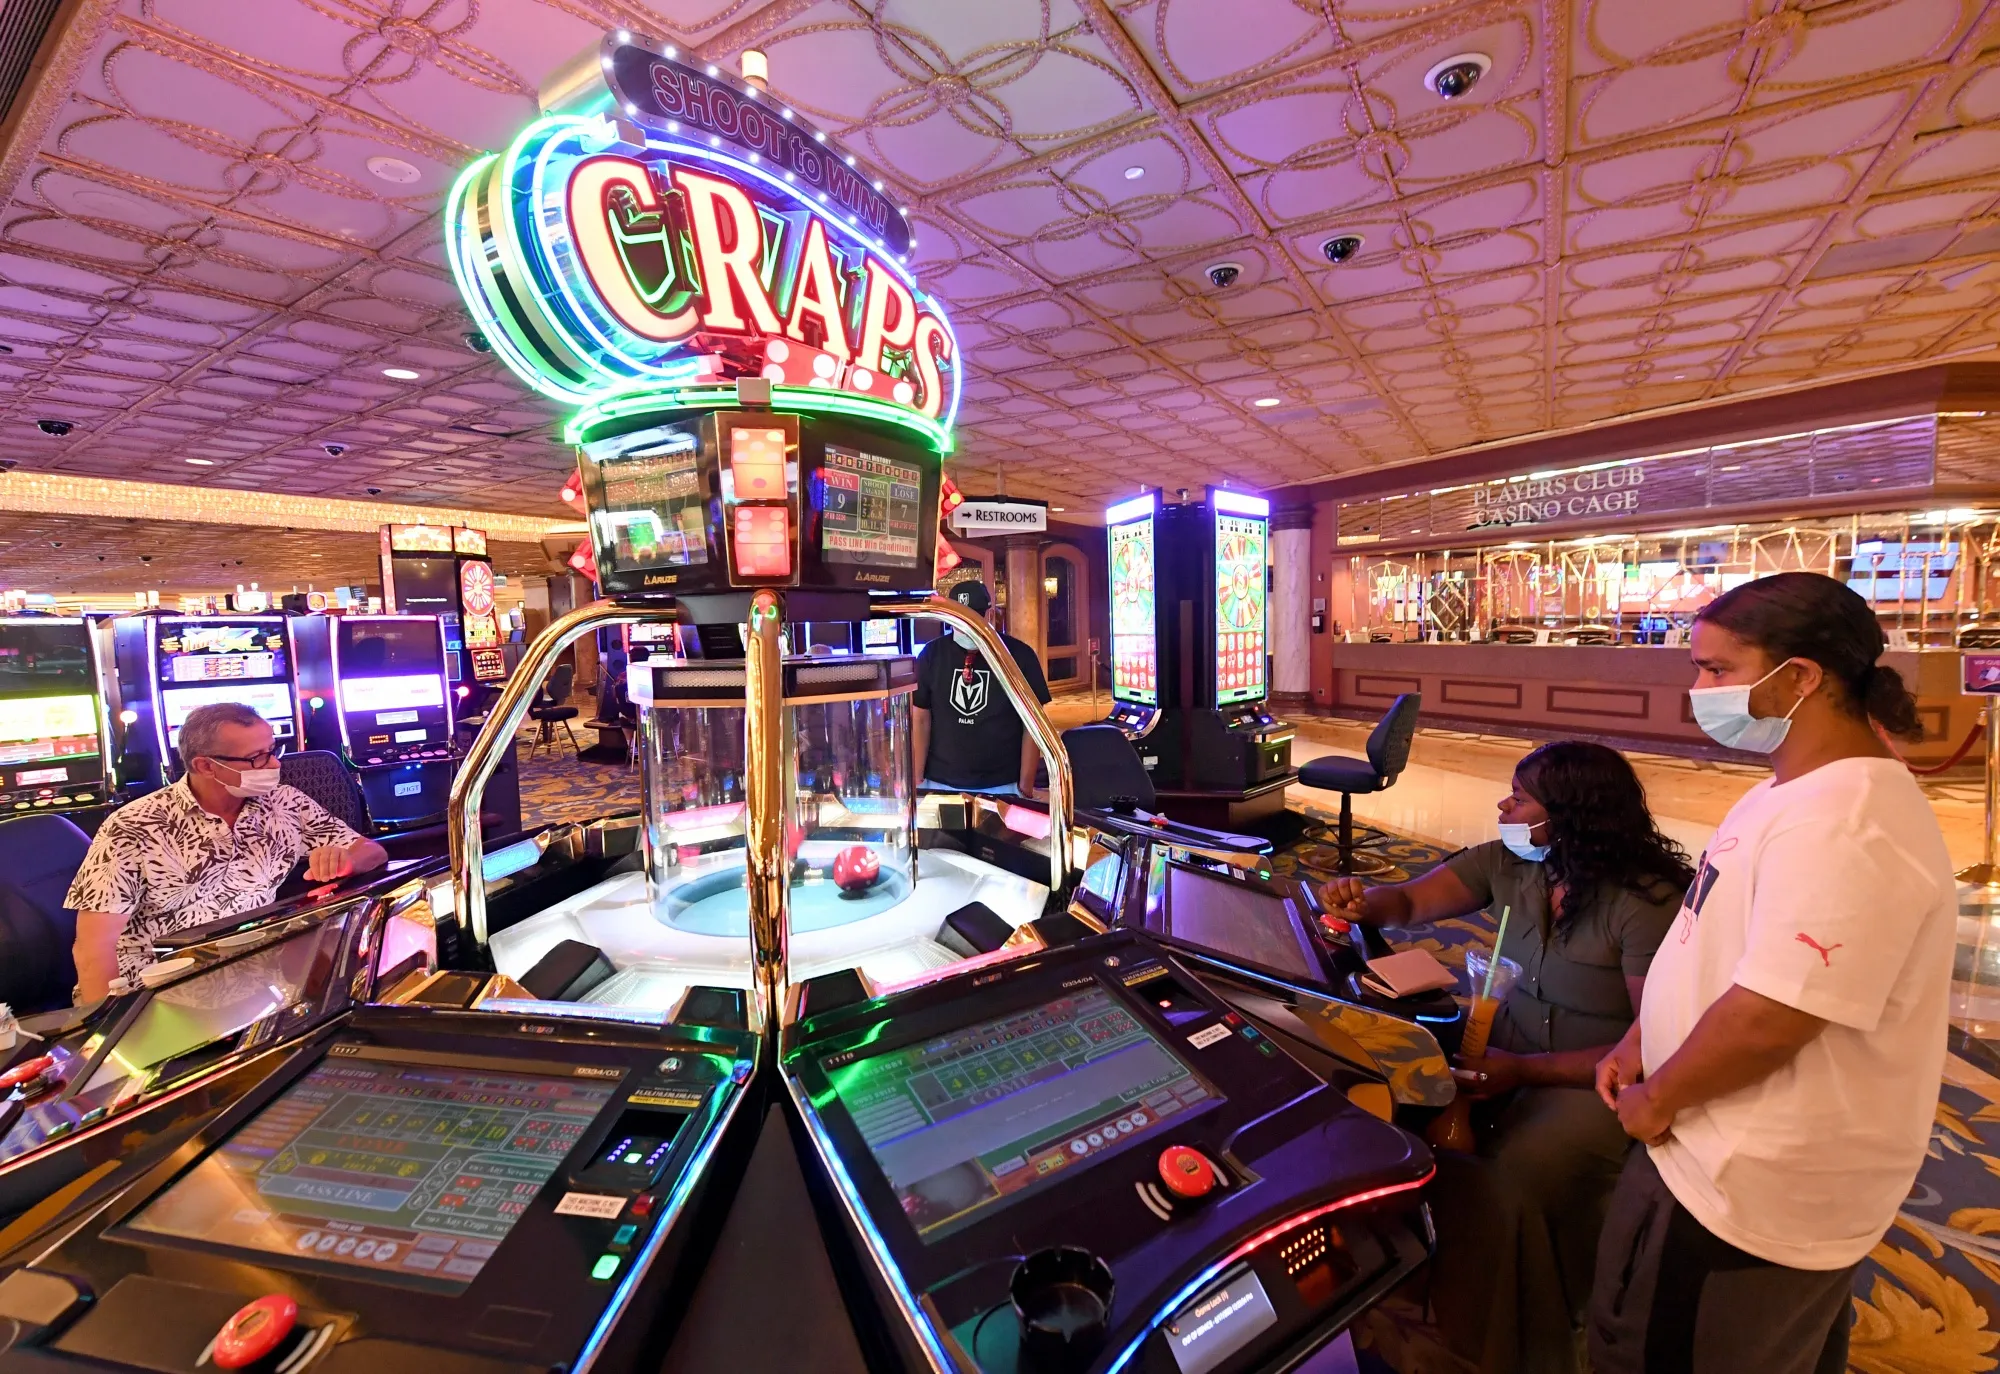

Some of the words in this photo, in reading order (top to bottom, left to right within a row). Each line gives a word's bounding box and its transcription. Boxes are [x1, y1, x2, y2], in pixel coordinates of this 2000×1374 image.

[651, 63, 786, 160] SHOOT
[789, 135, 822, 183] to
[826, 156, 888, 234] WIN!
[566, 153, 954, 420] CRAPS
[831, 476, 853, 488] WIN
[864, 480, 885, 490] SHOOT
[1474, 476, 1567, 507] PLAYERS
[1574, 466, 1645, 493] CLUB
[894, 488, 914, 500] LOSE
[838, 494, 846, 509] 9
[1475, 500, 1561, 526] CASINO
[1568, 490, 1639, 516] CAGE
[901, 504, 908, 518] 7
[976, 509, 1037, 523] RESTROOMS
[829, 536, 847, 546] PASS
[848, 537, 863, 548] LINE
[864, 540, 878, 550] Win
[878, 541, 912, 553] Conditions
[651, 575, 678, 584] ARUZE
[864, 573, 890, 583] ARUZE
[406, 784, 420, 794] IGT
